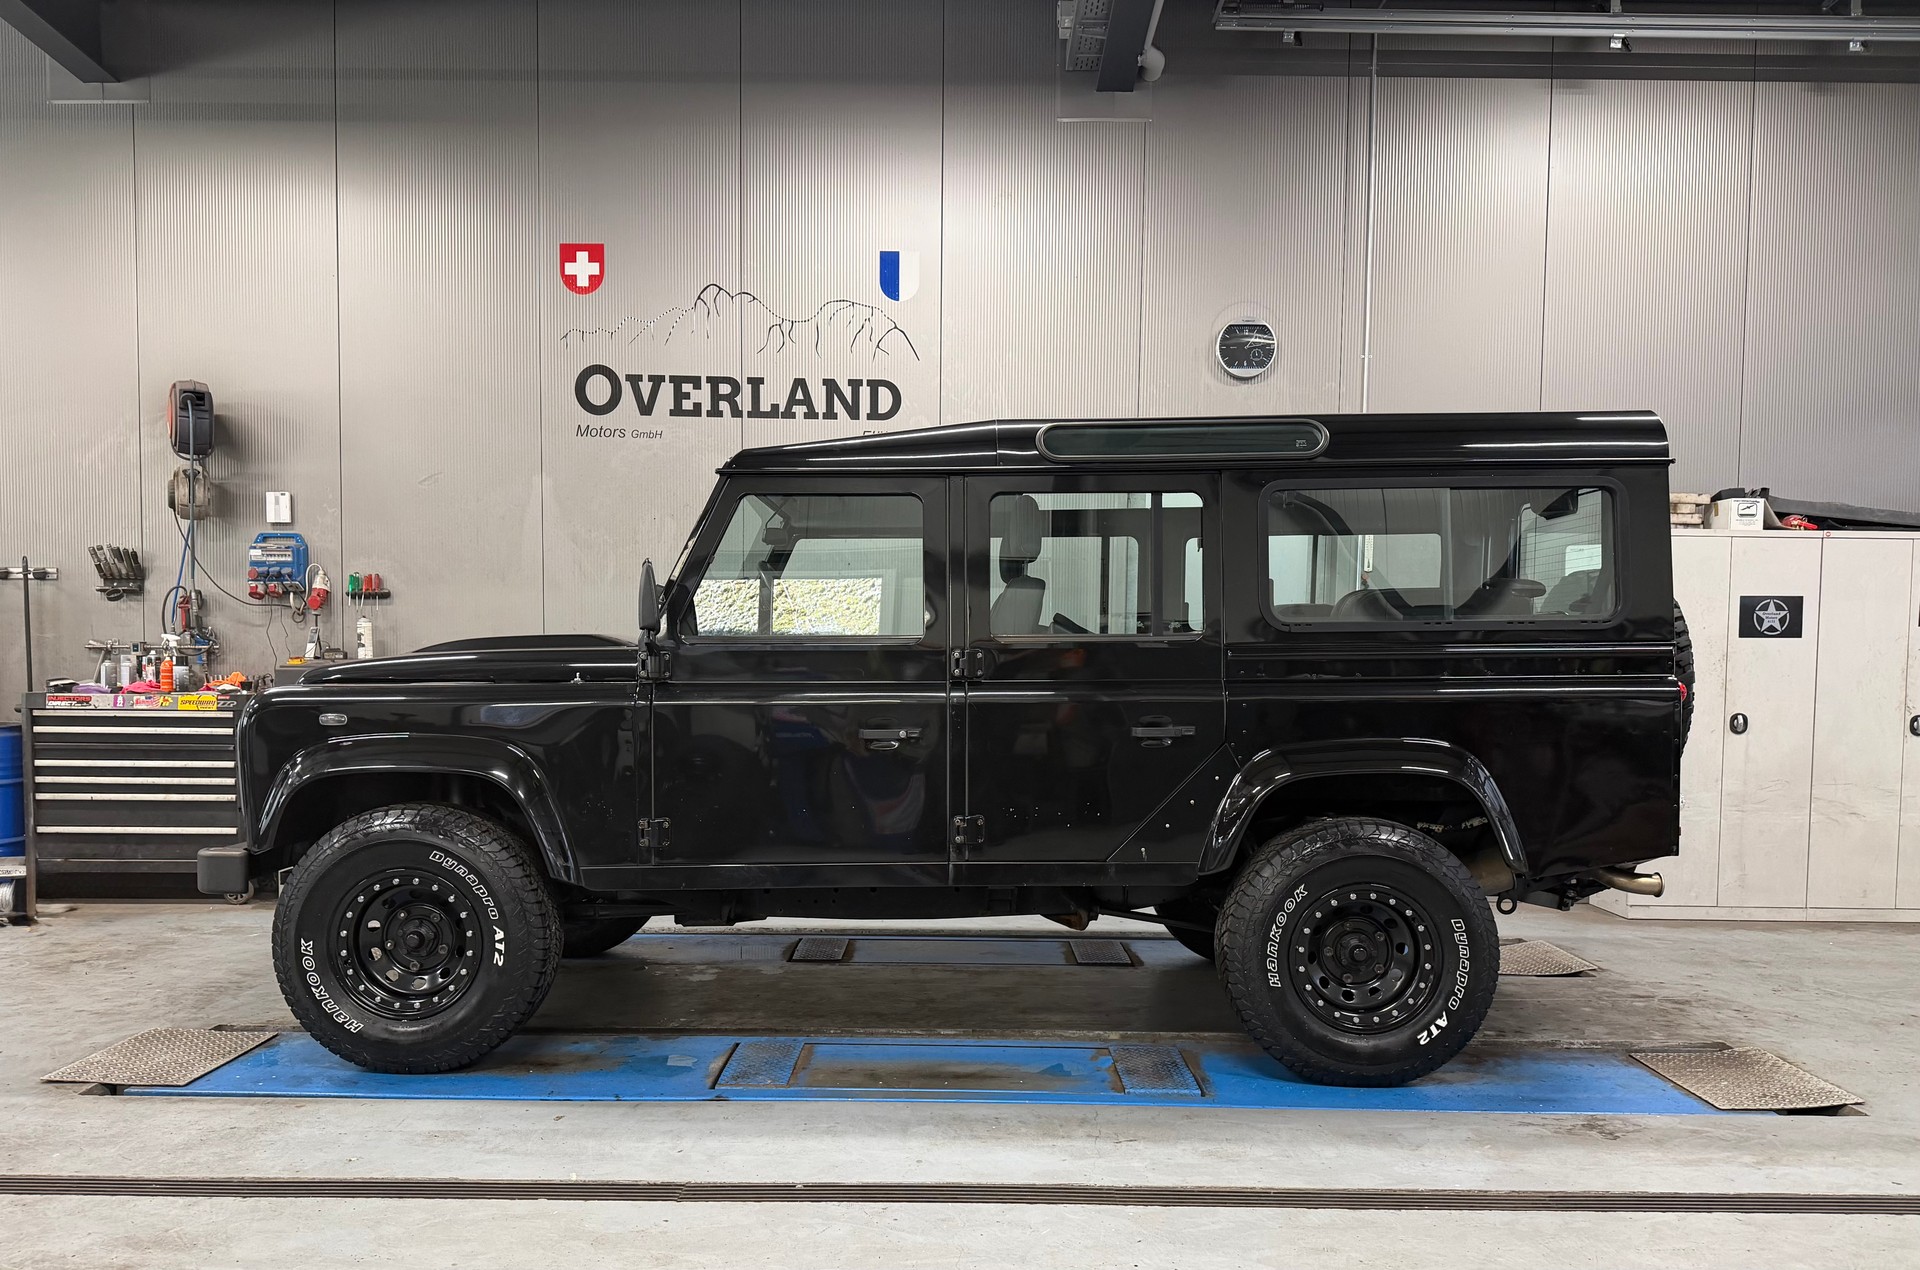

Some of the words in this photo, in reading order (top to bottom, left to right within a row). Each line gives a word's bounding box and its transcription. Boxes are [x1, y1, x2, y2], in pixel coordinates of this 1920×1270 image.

[574, 363, 903, 421] OVERLAND
[575, 424, 627, 439] Motors
[630, 429, 664, 439] GmbH
[492, 925, 505, 968] AT2
[1416, 1010, 1450, 1046] AT2
